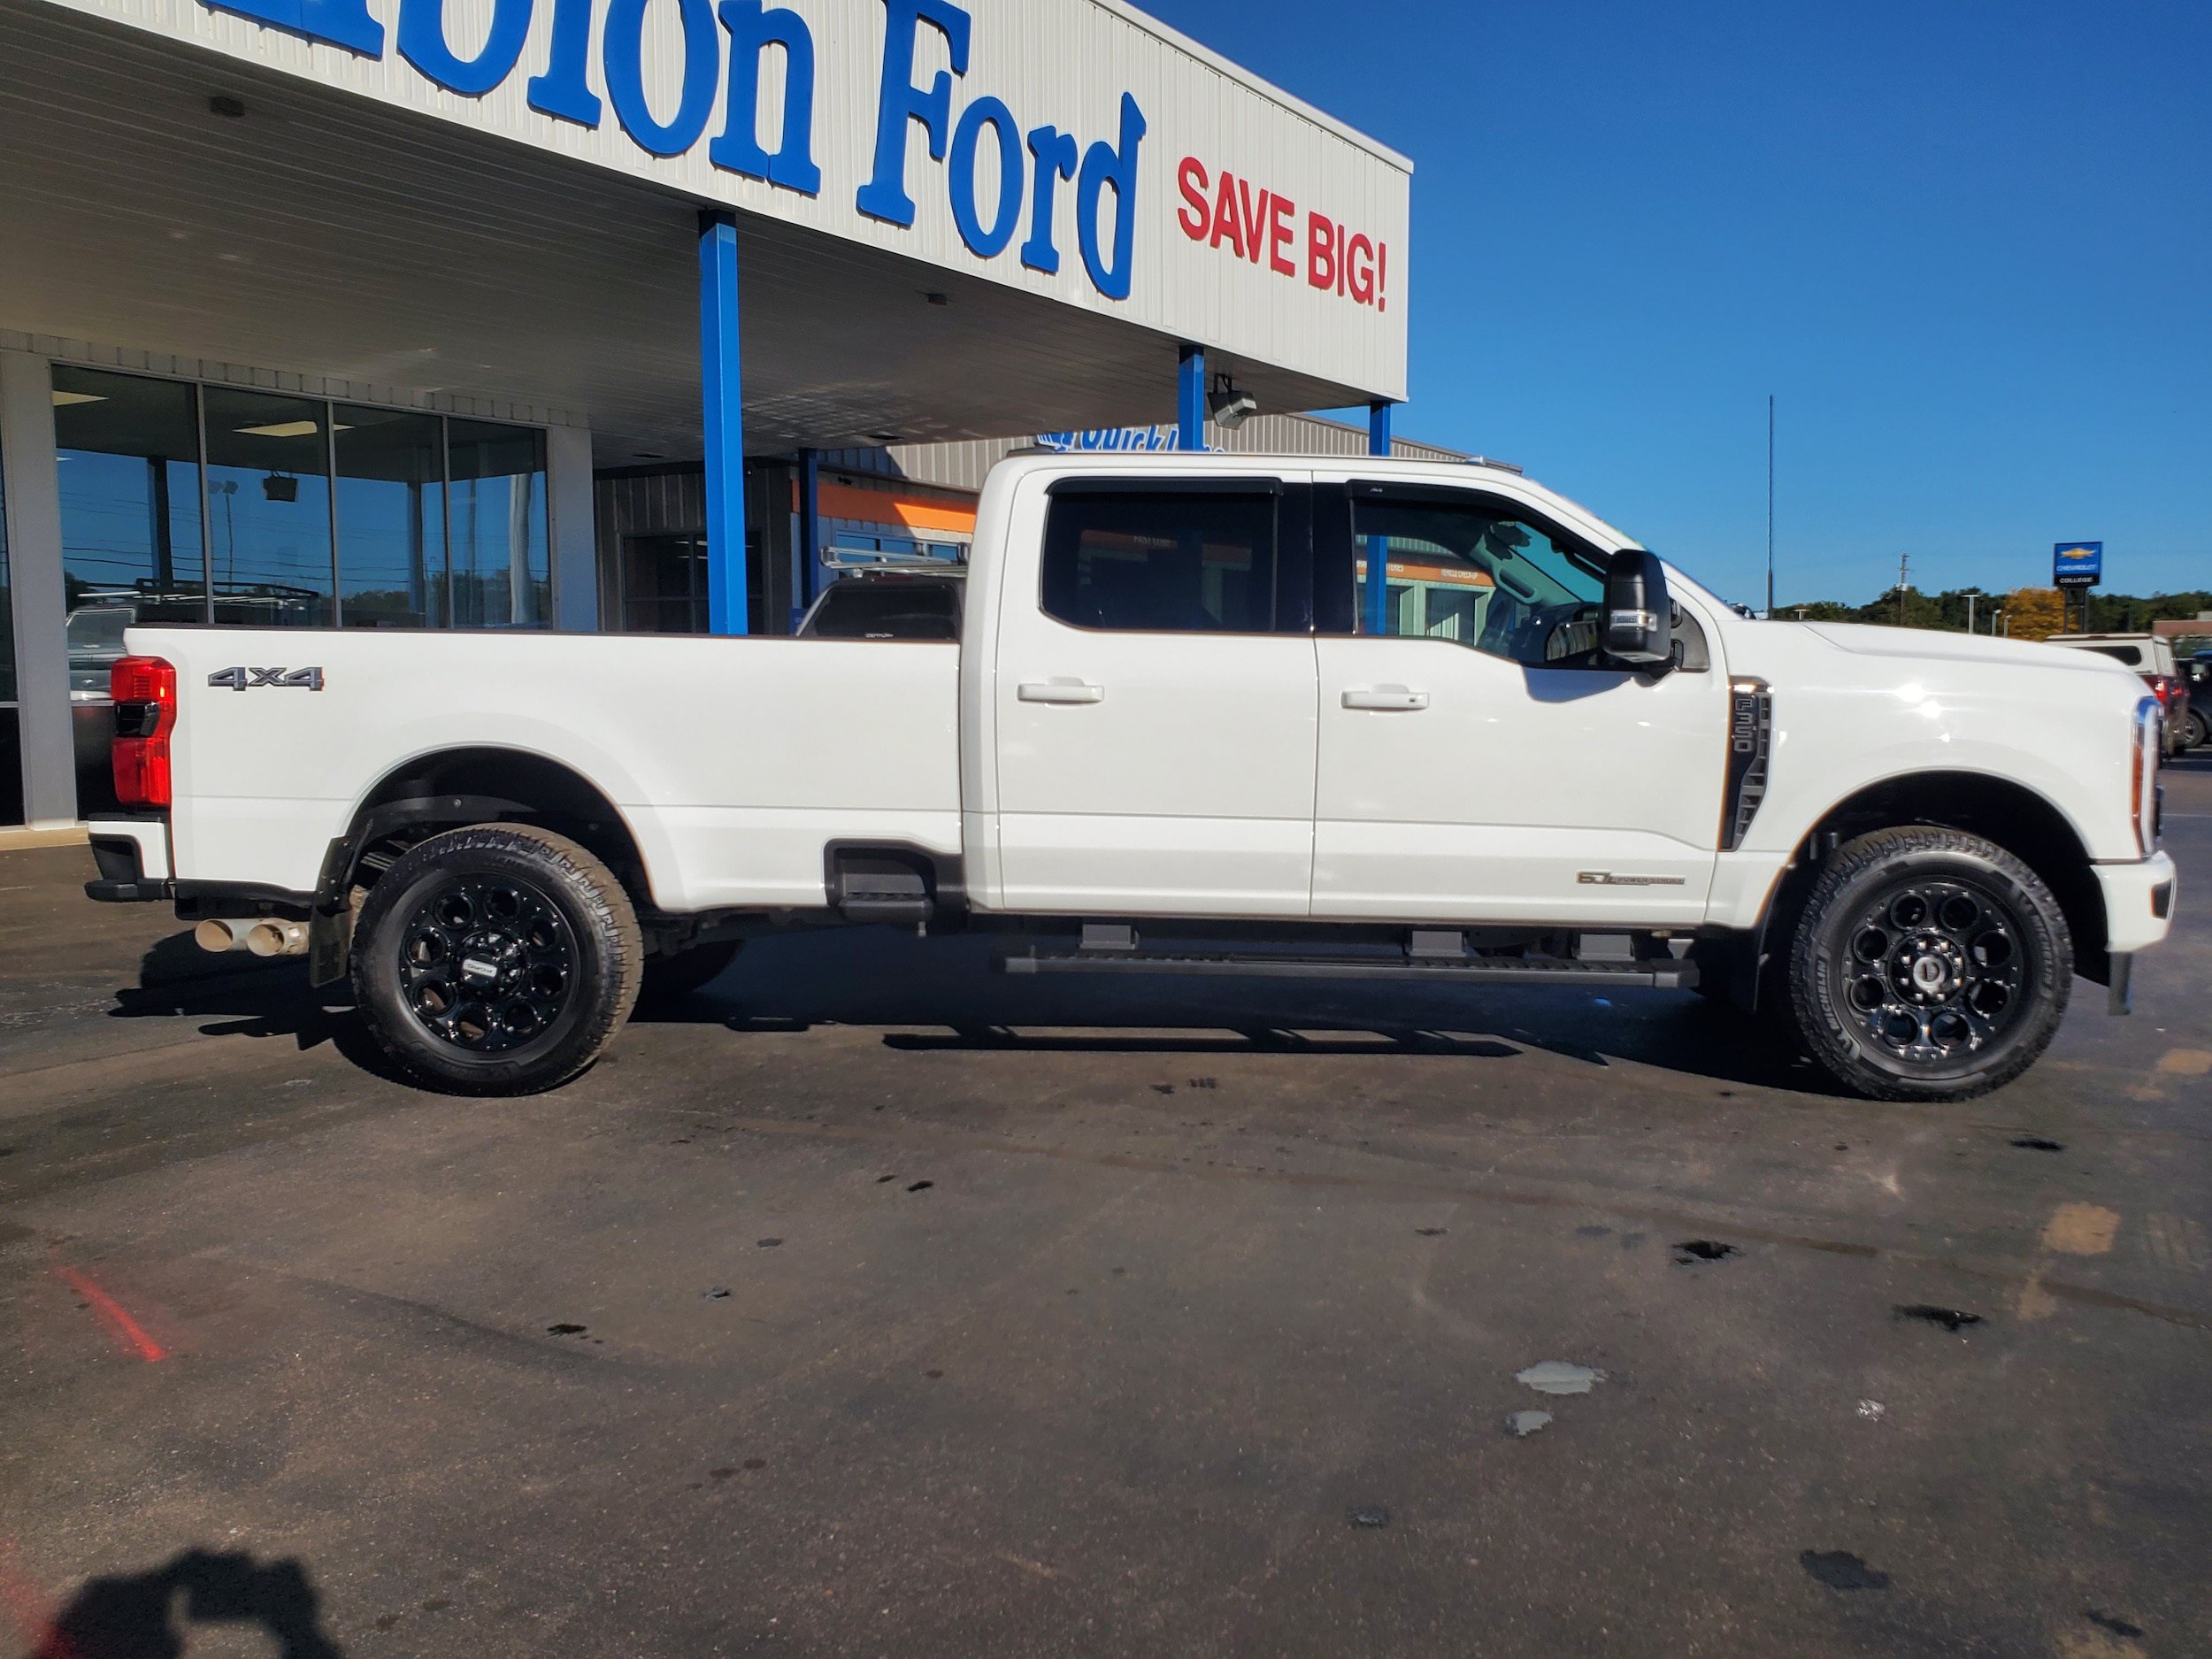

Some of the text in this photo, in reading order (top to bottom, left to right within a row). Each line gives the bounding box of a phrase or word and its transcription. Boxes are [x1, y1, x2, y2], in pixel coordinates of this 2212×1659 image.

[856, 0, 1147, 300] Ford
[1178, 157, 1386, 312] SAVE BIG!
[1816, 959, 1840, 1030] MICHELIN
